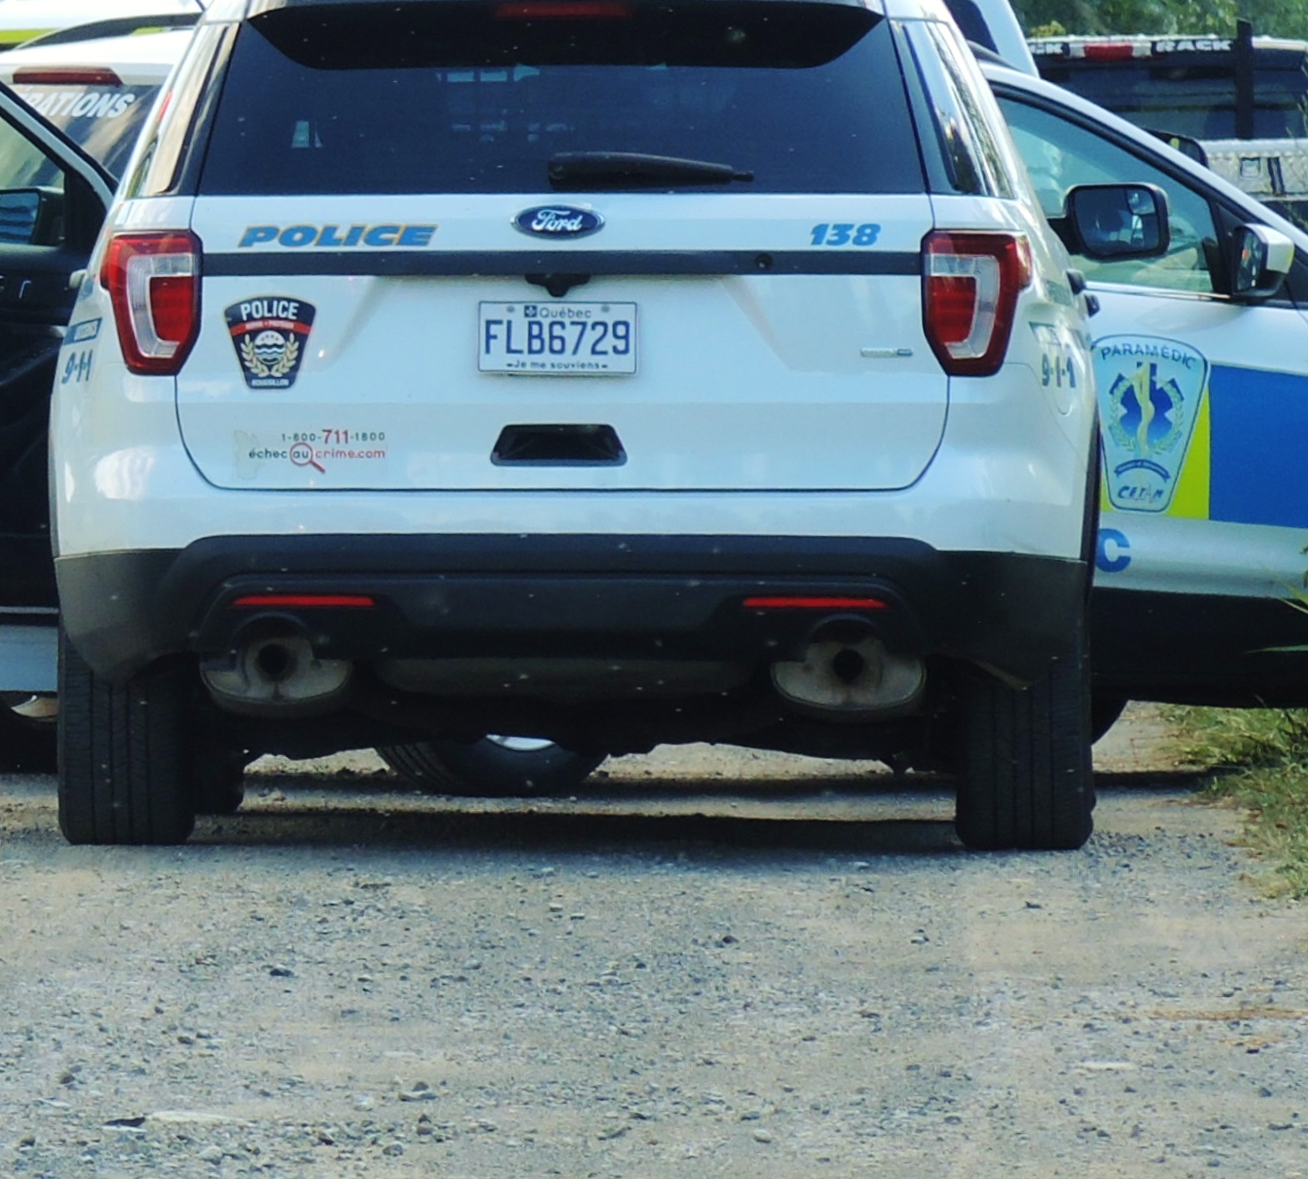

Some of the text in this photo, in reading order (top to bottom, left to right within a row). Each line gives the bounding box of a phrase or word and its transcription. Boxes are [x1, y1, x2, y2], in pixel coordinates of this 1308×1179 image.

[1156, 39, 1233, 51] RACK
[531, 209, 582, 232] Ford
[238, 224, 439, 248] POLICE
[810, 223, 881, 246] 138
[240, 300, 299, 321] POLICE
[539, 306, 592, 318] Québec
[485, 320, 630, 356] FLB6729
[530, 361, 546, 369] me
[550, 360, 600, 369] souviens
[1100, 342, 1197, 370] PARAMÉDIC
[282, 429, 386, 444] 1-800-711-1800
